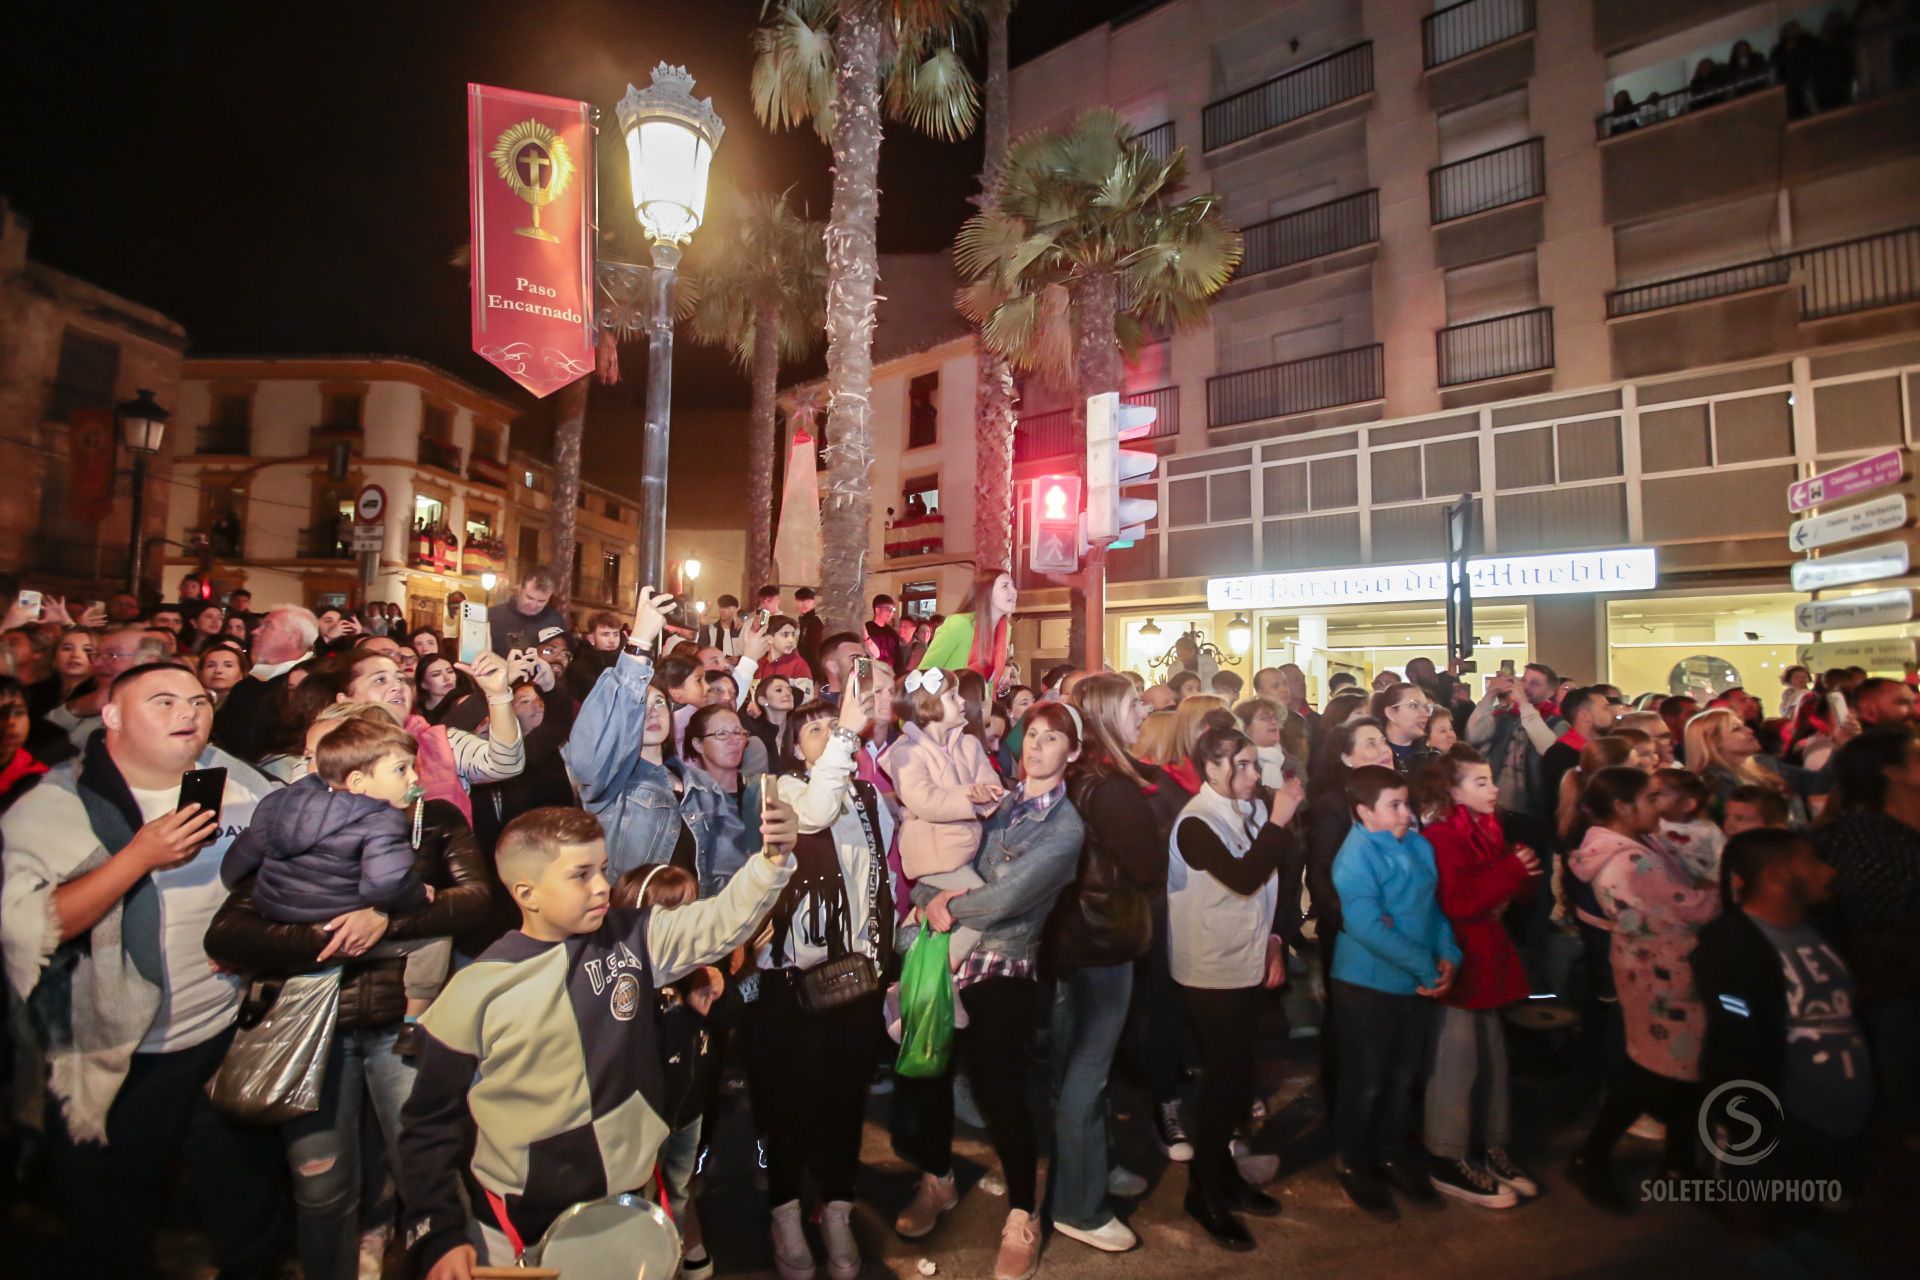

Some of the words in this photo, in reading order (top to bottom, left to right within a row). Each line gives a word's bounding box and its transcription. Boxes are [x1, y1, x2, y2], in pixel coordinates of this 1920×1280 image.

[515, 277, 557, 298] Paso
[487, 294, 582, 324] Encarnado
[1473, 557, 1632, 587] Mueble
